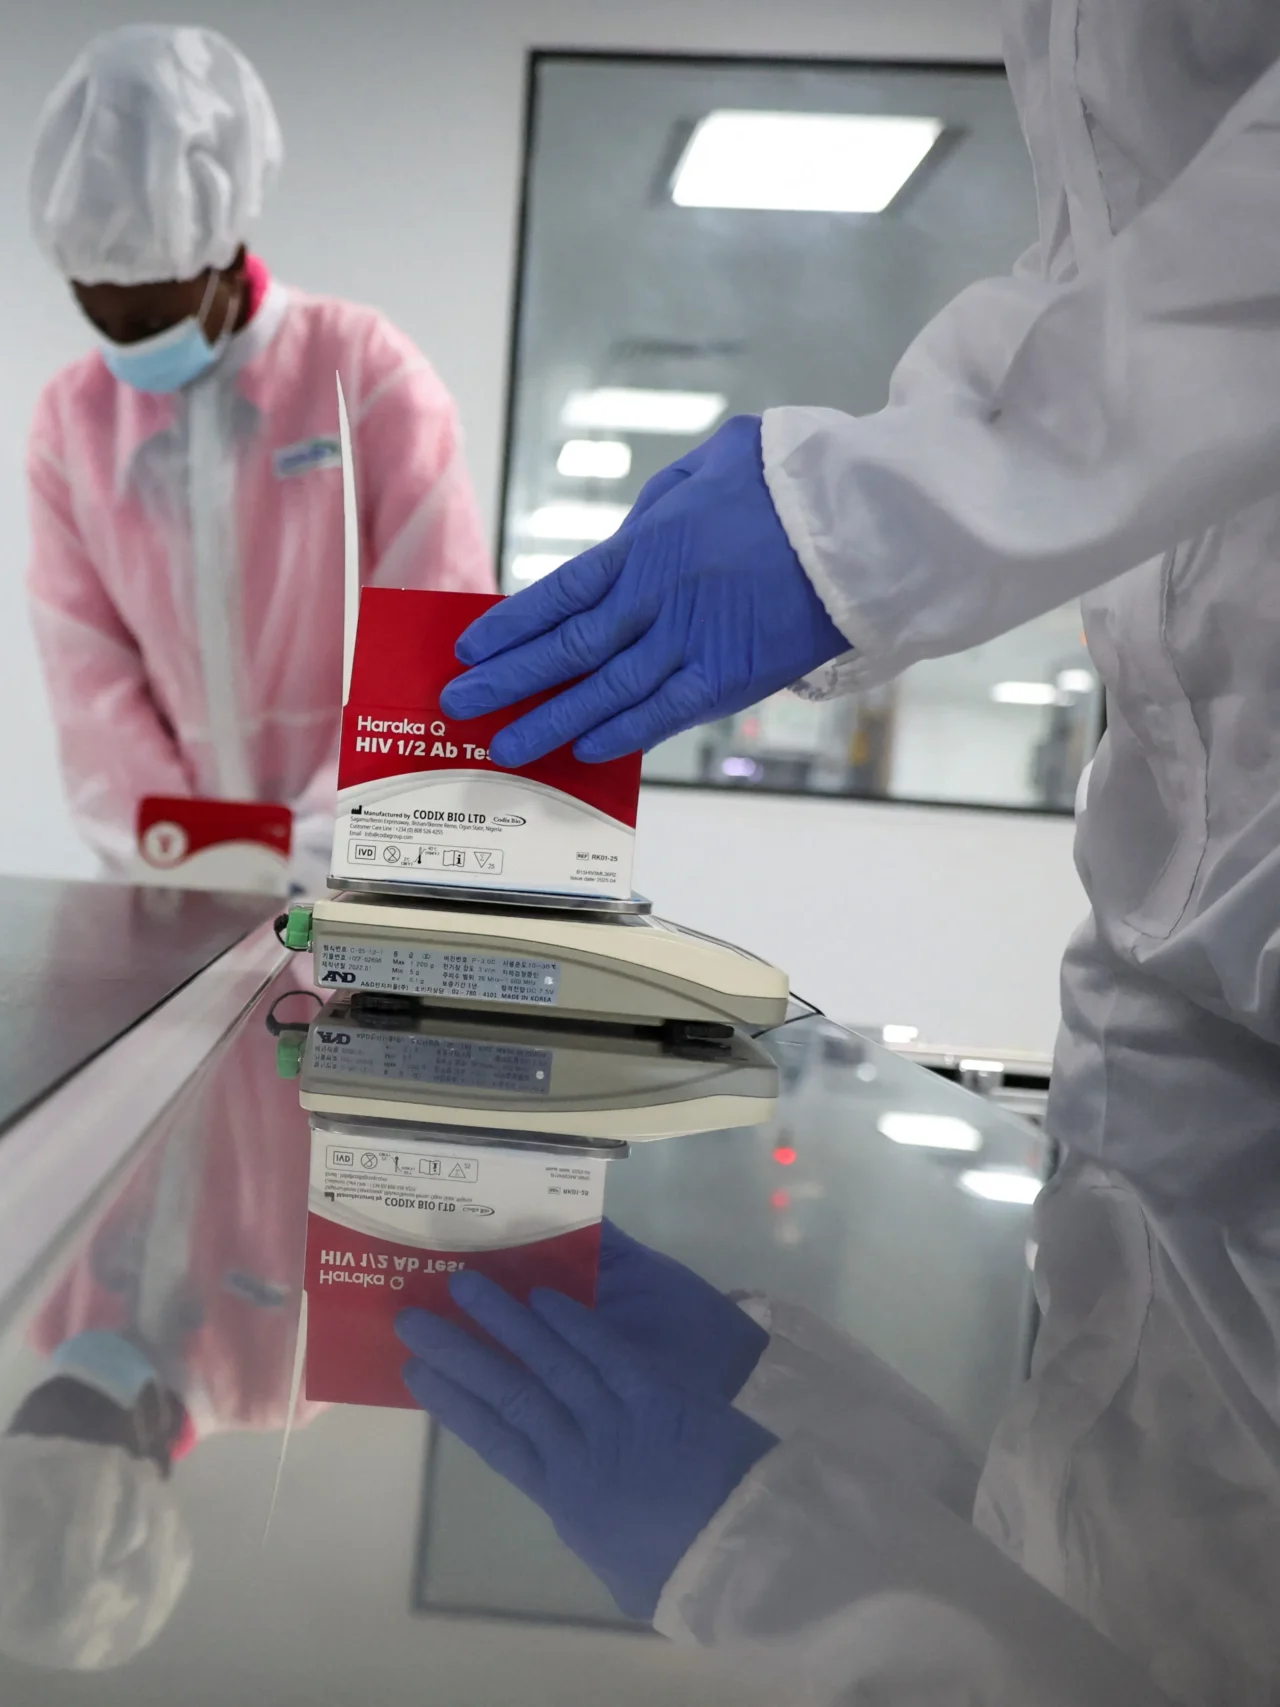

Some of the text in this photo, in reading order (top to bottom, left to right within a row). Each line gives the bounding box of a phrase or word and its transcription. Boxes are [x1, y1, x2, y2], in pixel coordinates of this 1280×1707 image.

[357, 715, 446, 736] Haraka Q
[355, 737, 492, 761] HIV 1/2 Ab Te
[364, 810, 402, 818] Manufactured
[413, 809, 444, 821] CODIX
[447, 812, 465, 822] BIO
[468, 814, 486, 824] LTD
[358, 848, 373, 857] IVD
[591, 854, 618, 862] RK01-25
[321, 970, 356, 984] AND
